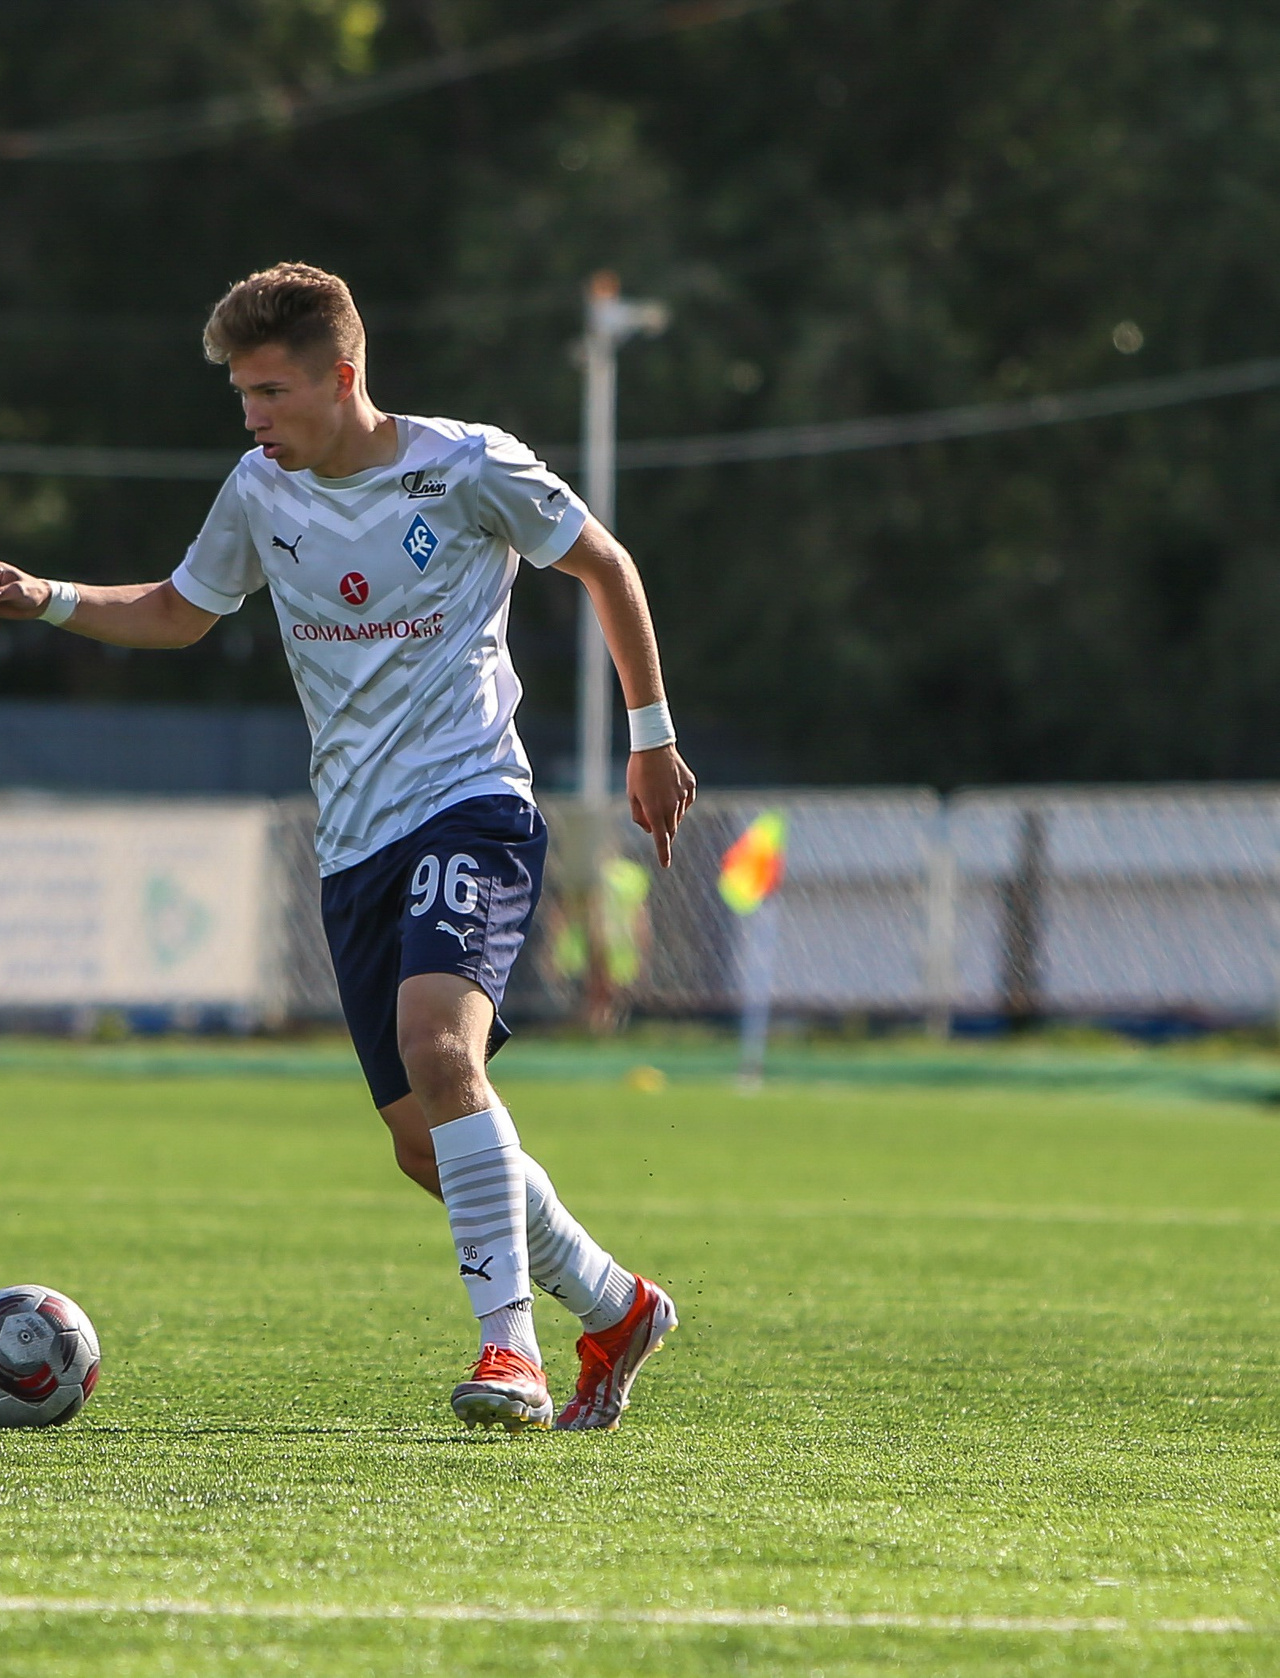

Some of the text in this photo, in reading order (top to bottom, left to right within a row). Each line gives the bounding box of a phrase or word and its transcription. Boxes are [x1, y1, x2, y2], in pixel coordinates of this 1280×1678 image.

[292, 612, 444, 642] СОЛИДАРНОС
[412, 623, 444, 640] АНК
[410, 853, 480, 917] 96
[463, 1245, 478, 1261] 96
